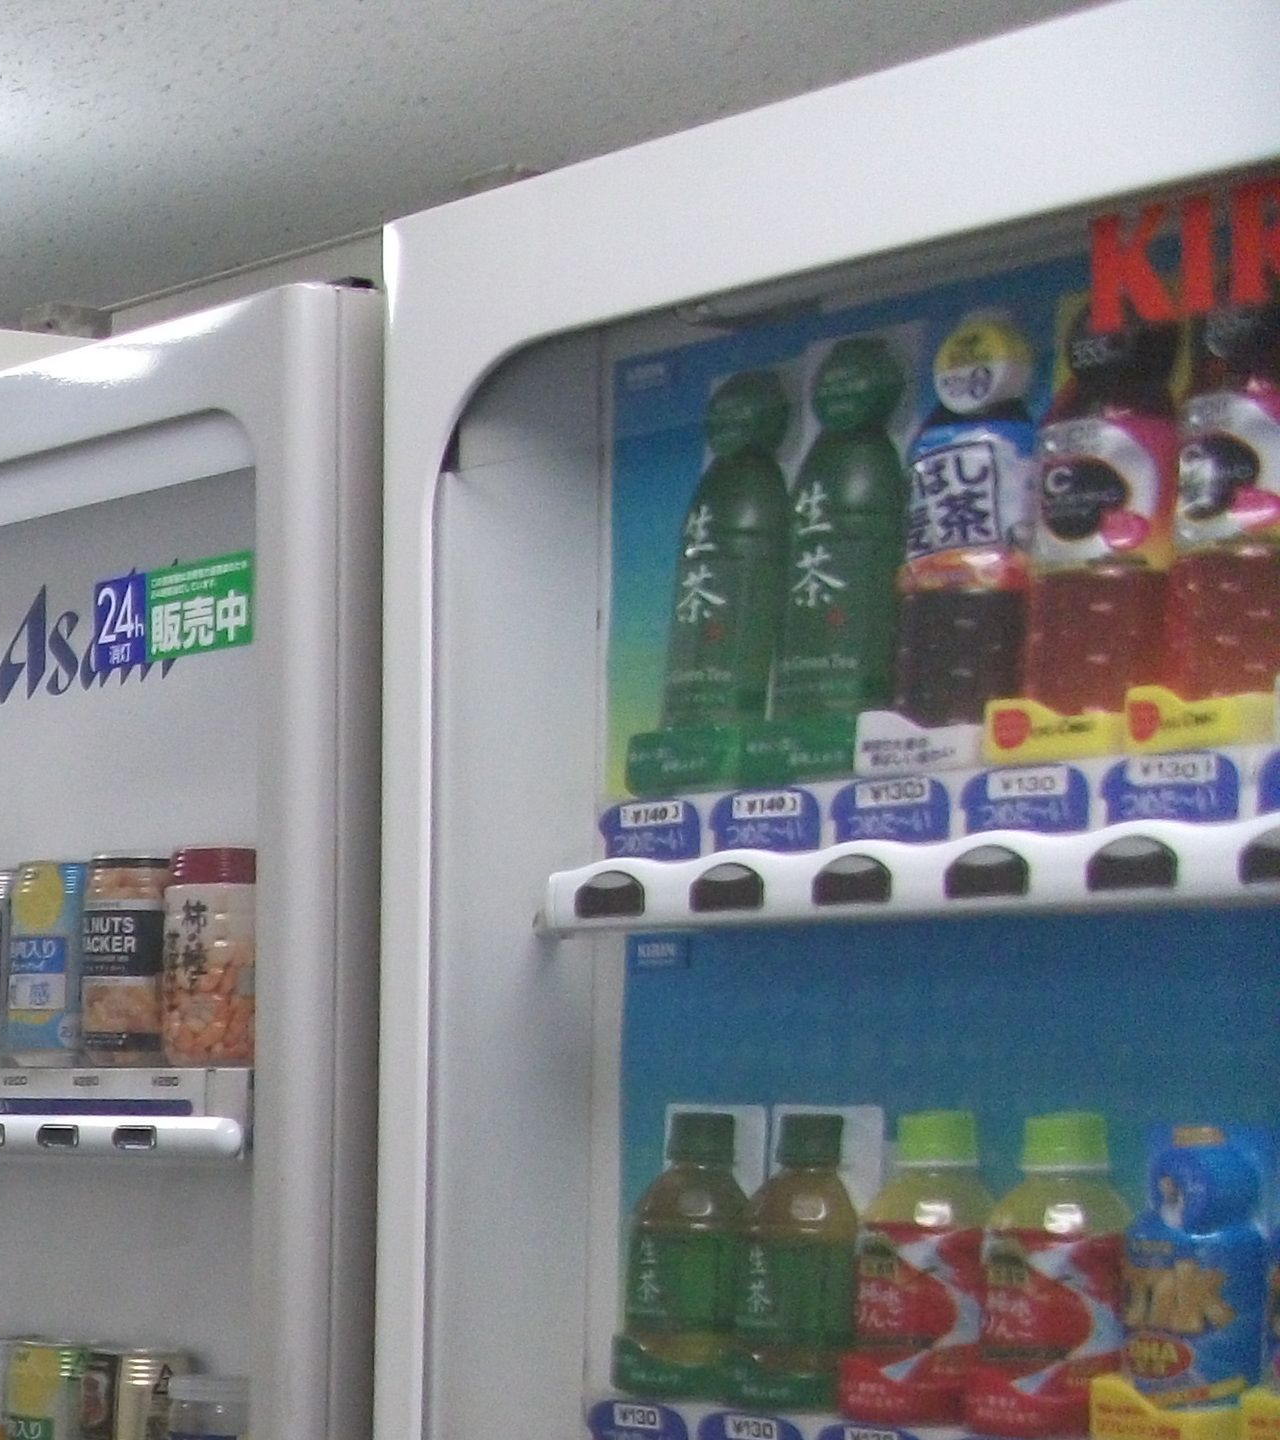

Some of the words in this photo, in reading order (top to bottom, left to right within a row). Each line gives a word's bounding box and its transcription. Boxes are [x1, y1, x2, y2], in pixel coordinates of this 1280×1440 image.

[1089, 178, 1280, 333] KIR
[676, 504, 727, 623] 生茶
[792, 480, 846, 607] 生茶
[150, 590, 247, 655] 販売中
[87, 936, 137, 954] ACKER
[618, 1406, 658, 1426] ¥130
[732, 1418, 775, 1439] ¥130
